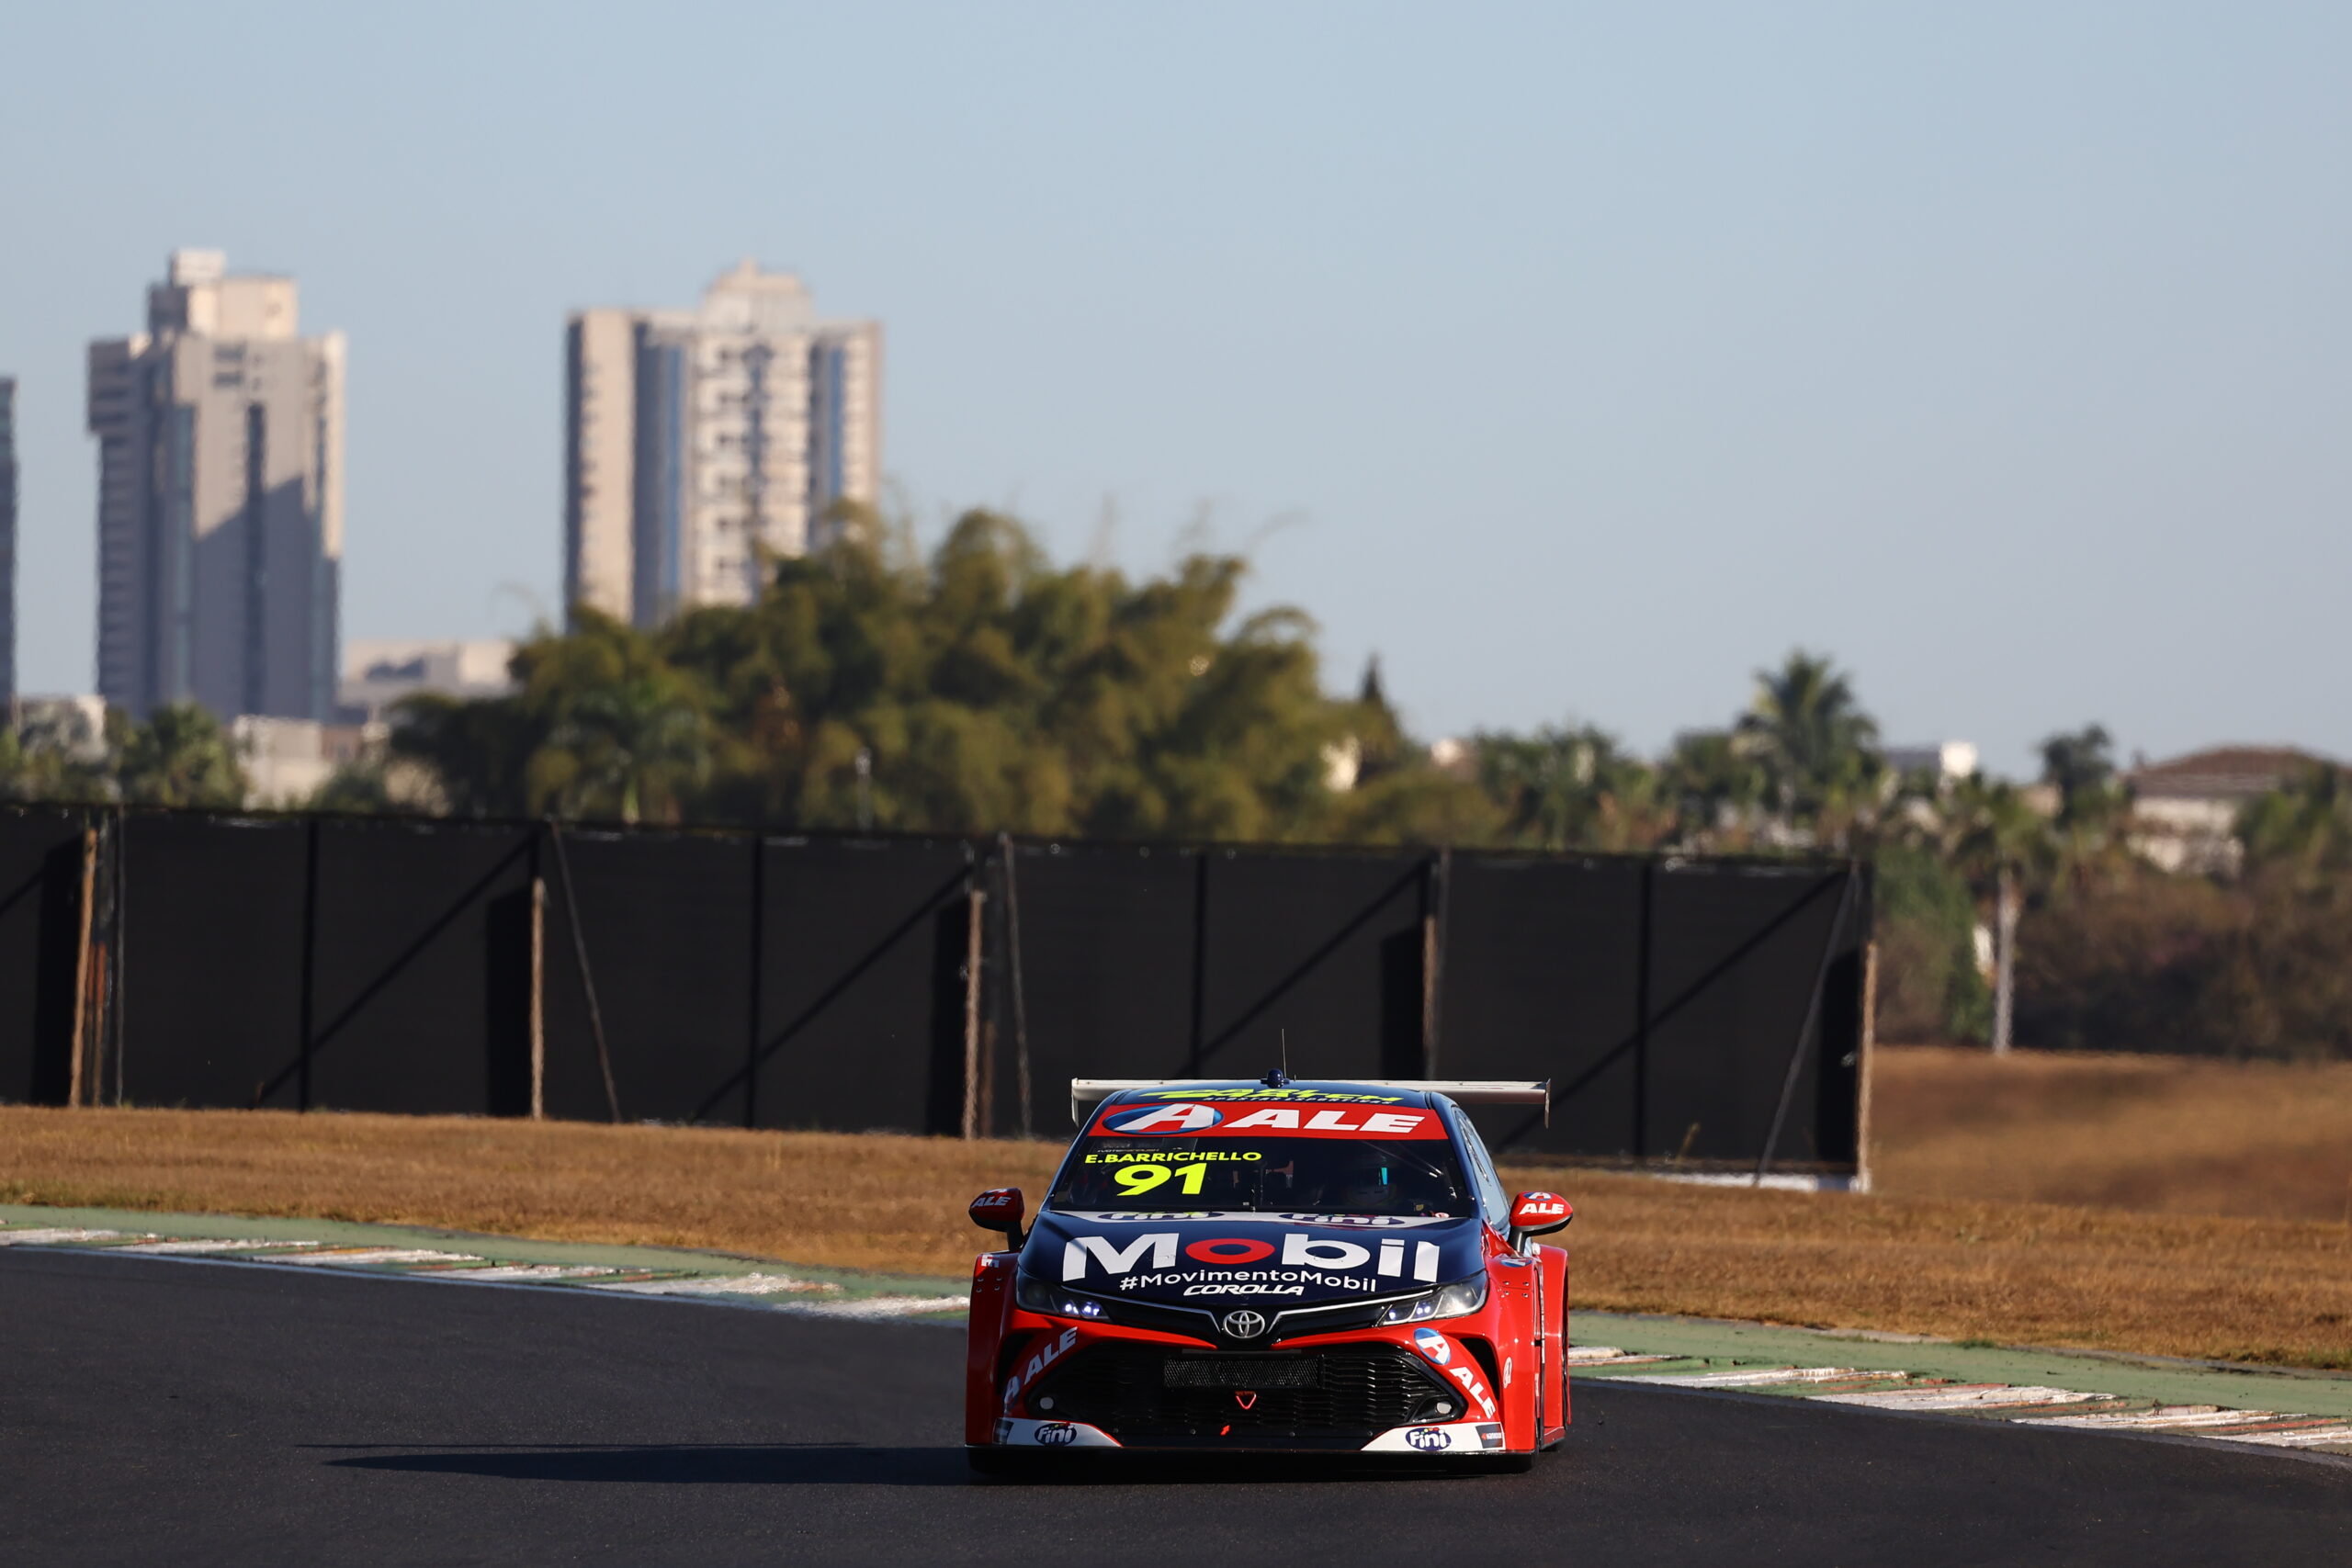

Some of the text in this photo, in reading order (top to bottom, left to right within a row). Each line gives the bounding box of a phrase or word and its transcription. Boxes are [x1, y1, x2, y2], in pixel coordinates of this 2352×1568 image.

[1113, 1103, 1425, 1134] A ALE
[1085, 1151, 1262, 1164] E.BARRICHELLO
[1114, 1162, 1207, 1196] 91
[971, 1196, 1012, 1207] ALE
[1519, 1202, 1565, 1214] ALE
[1062, 1233, 1441, 1283] Mobil
[1119, 1269, 1376, 1292] #MovimentoMobil
[1182, 1284, 1305, 1296] COROLLA
[1023, 1325, 1078, 1385] ALE
[1449, 1366, 1497, 1419] ALE
[1036, 1425, 1076, 1444] Fini
[1409, 1429, 1448, 1449] Fini
